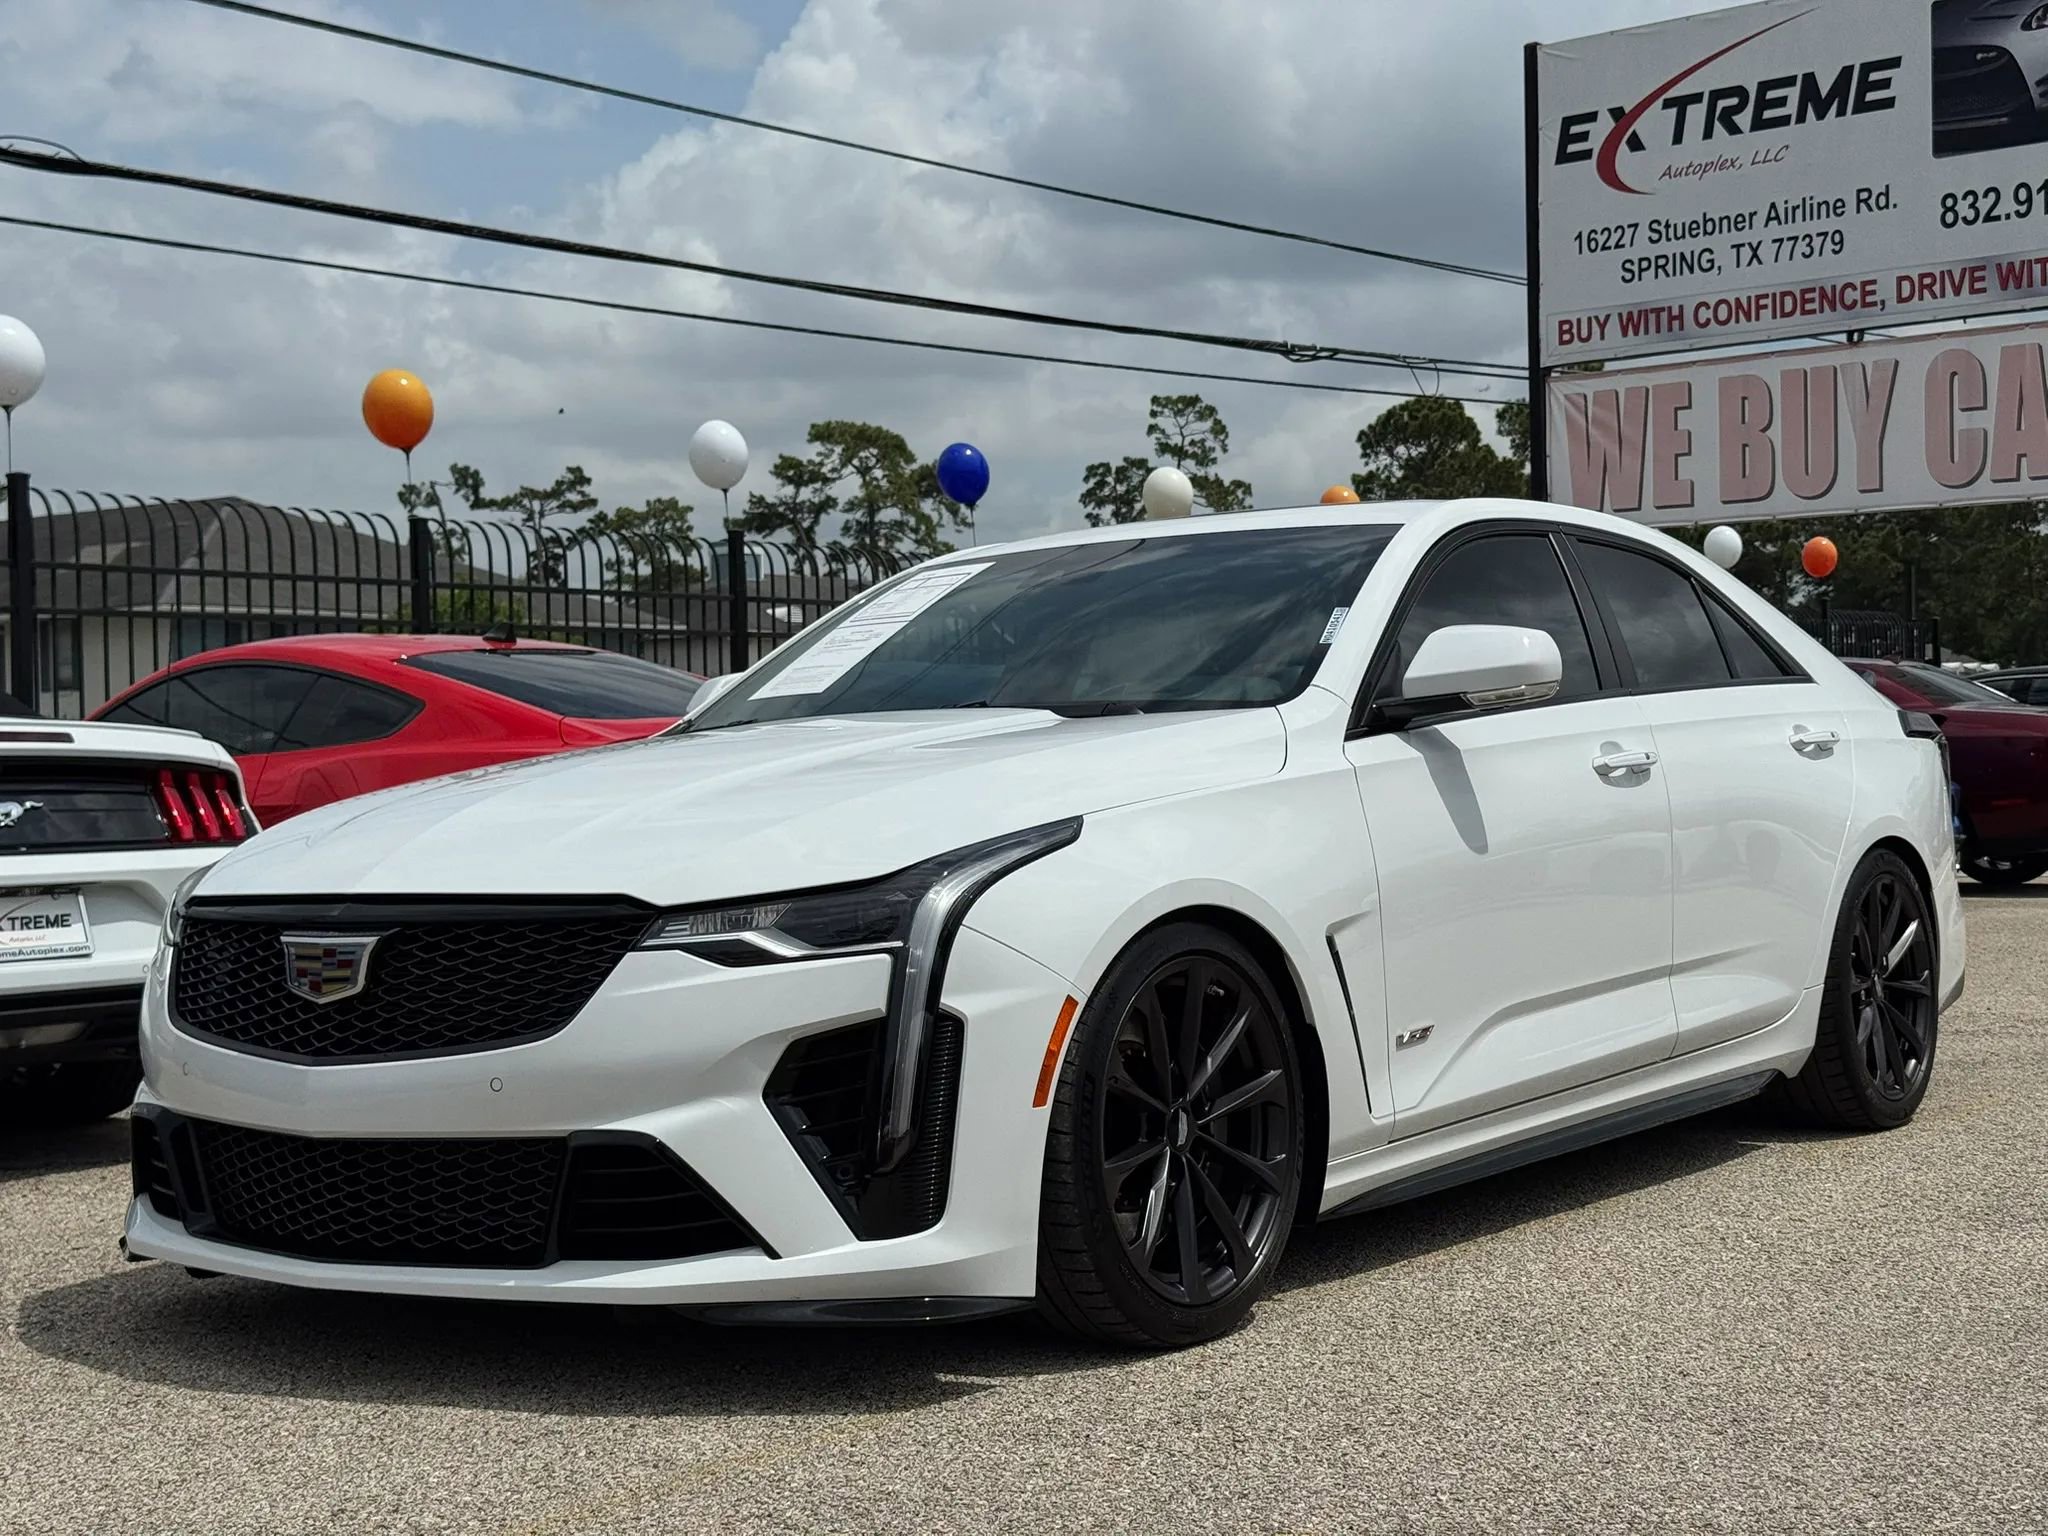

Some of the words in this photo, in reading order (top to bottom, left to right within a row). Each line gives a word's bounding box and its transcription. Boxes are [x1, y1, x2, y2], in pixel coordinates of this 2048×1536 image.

[1554, 55, 1903, 166] EXTREME
[1658, 153, 1744, 182] Autoplex,
[1750, 144, 1790, 168] LLC
[1573, 222, 1640, 255] 16227
[1647, 210, 1758, 245] Stuebner
[1763, 195, 1846, 228] Airline
[1855, 184, 1898, 214] Rd.
[1940, 178, 2048, 230] 832.91
[1620, 247, 1722, 283] SPRING,
[1731, 239, 1763, 268] TX
[1771, 229, 1844, 263] 77379
[1557, 313, 1611, 346] BUY
[1617, 304, 1685, 338] WITH
[1693, 278, 1886, 329] CONFIDENCE,
[1895, 265, 1988, 305] DRIVE
[1565, 381, 1694, 512] WE
[1718, 358, 1900, 505] BUY
[1924, 342, 2048, 490] CA
